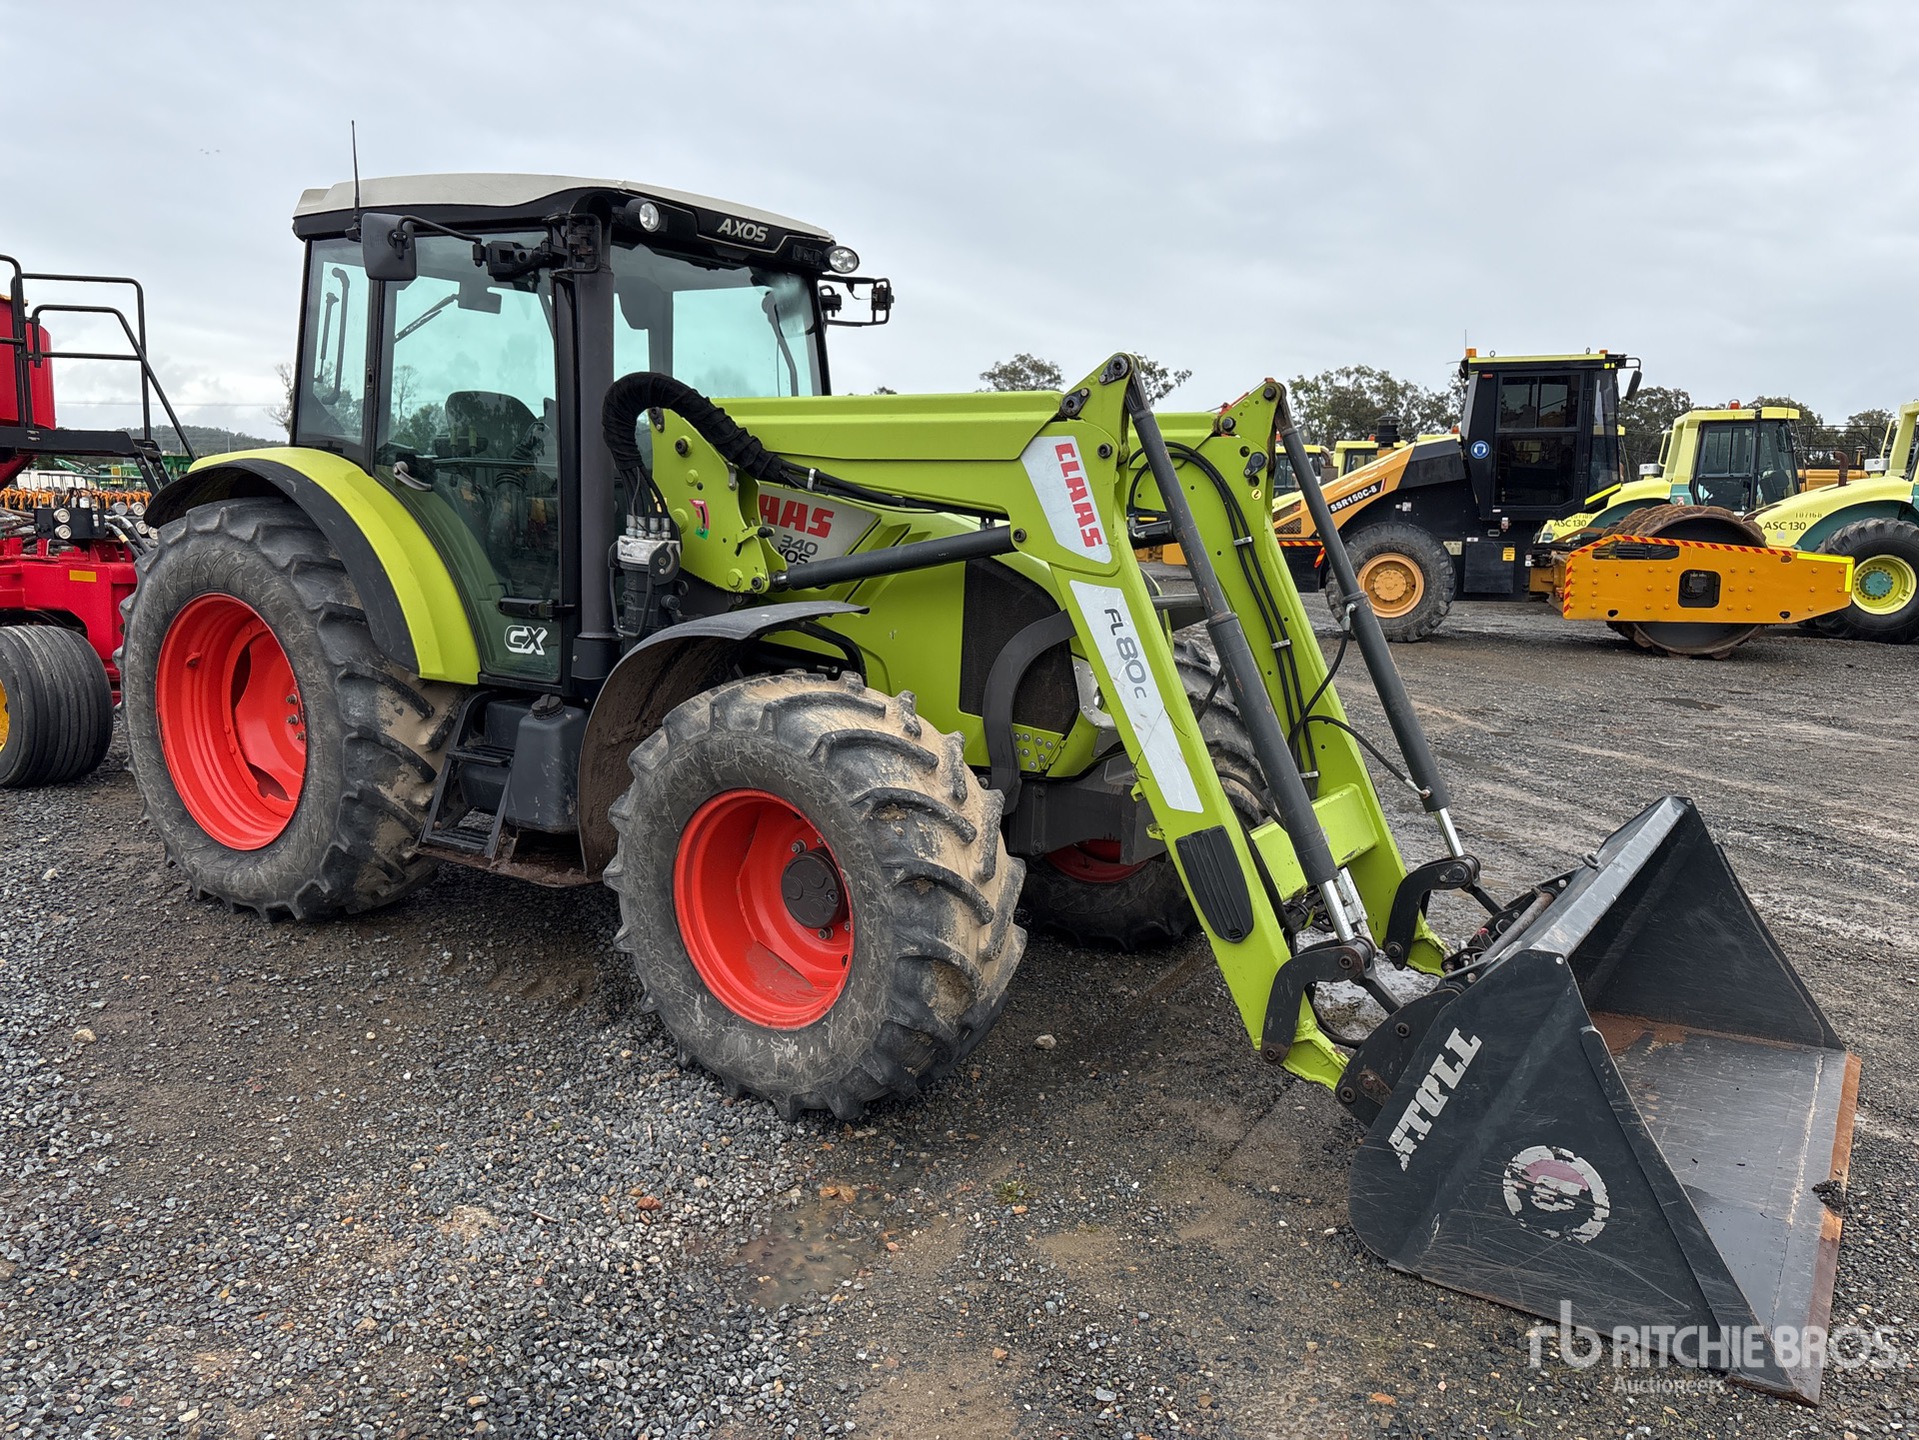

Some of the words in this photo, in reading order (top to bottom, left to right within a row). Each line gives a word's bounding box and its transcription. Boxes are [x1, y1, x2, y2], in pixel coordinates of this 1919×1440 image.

[717, 218, 769, 242] AXOS
[1055, 443, 1103, 547] CLAAS
[1330, 485, 1377, 512] SSR150C-8
[759, 494, 835, 539] AAS
[1554, 519, 1572, 528] ASC
[1573, 519, 1587, 528] 130
[1763, 521, 1787, 531] ASC
[1788, 521, 1807, 531] 130
[780, 534, 819, 556] 340
[504, 625, 548, 655] CX
[1388, 1027, 1483, 1171] STOLL
